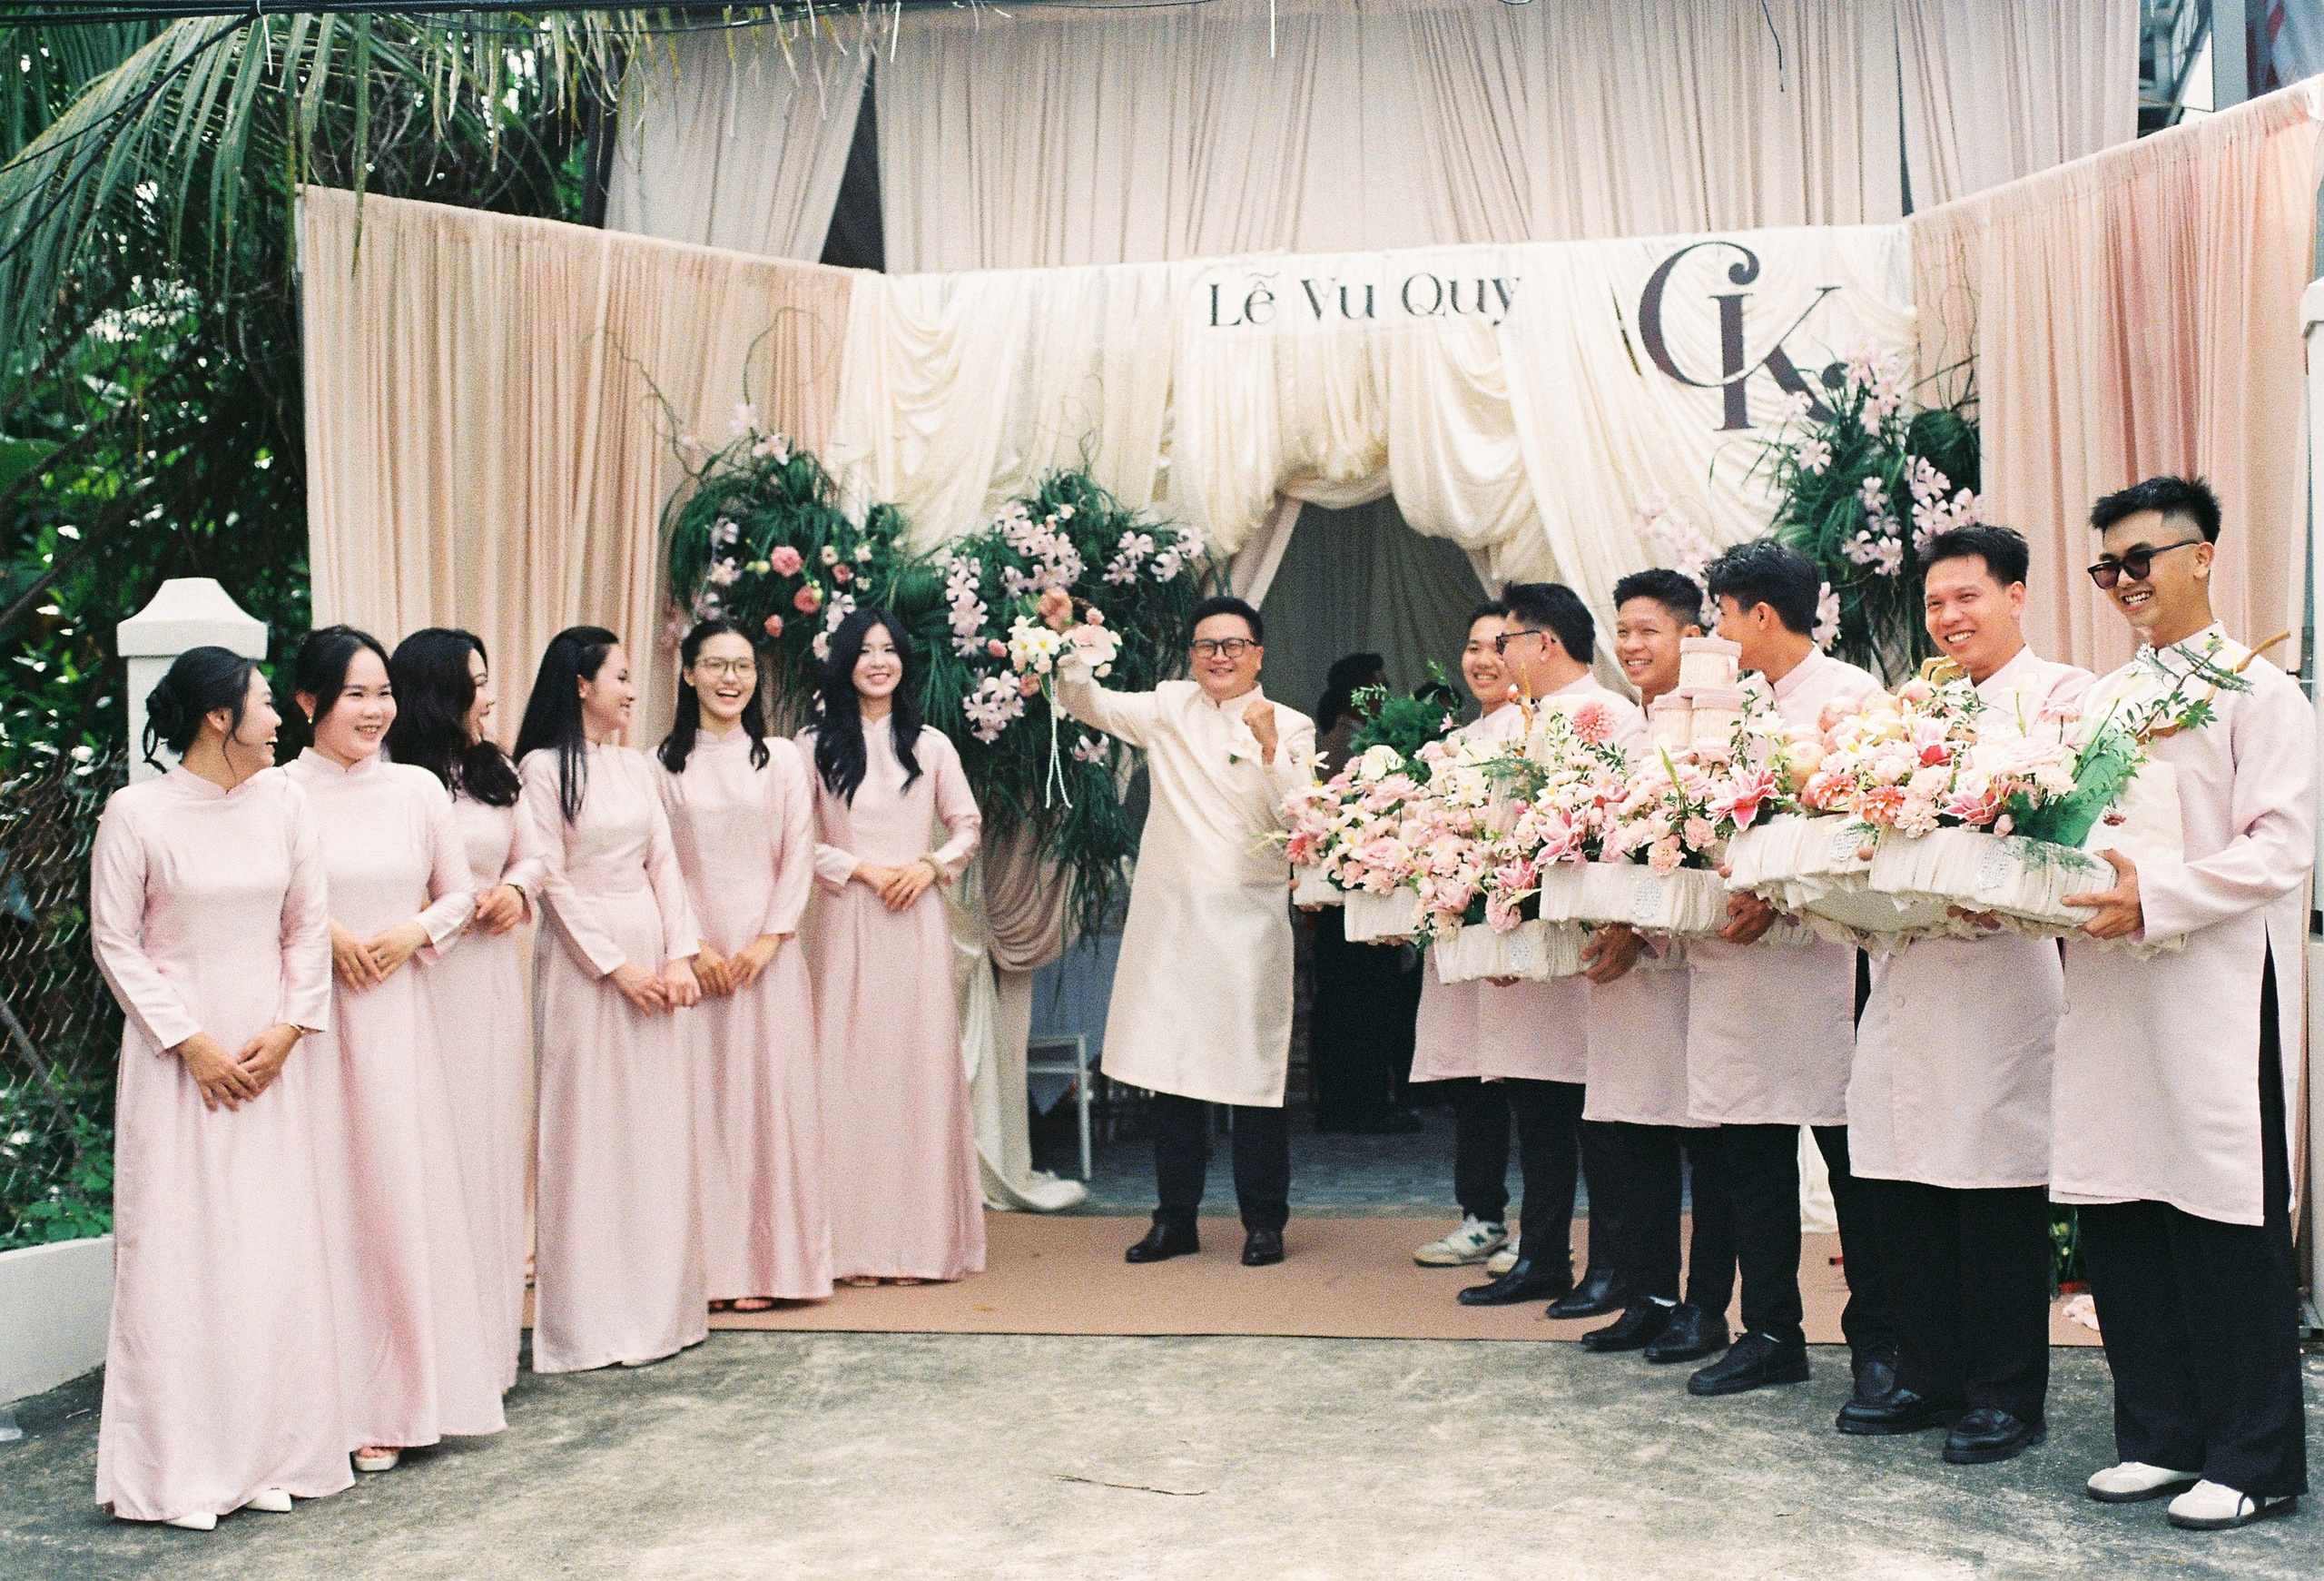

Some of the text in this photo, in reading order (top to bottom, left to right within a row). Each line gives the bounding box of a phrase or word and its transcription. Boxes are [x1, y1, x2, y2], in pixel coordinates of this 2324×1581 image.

[1208, 272, 1521, 327] Lễ Vu Quy
